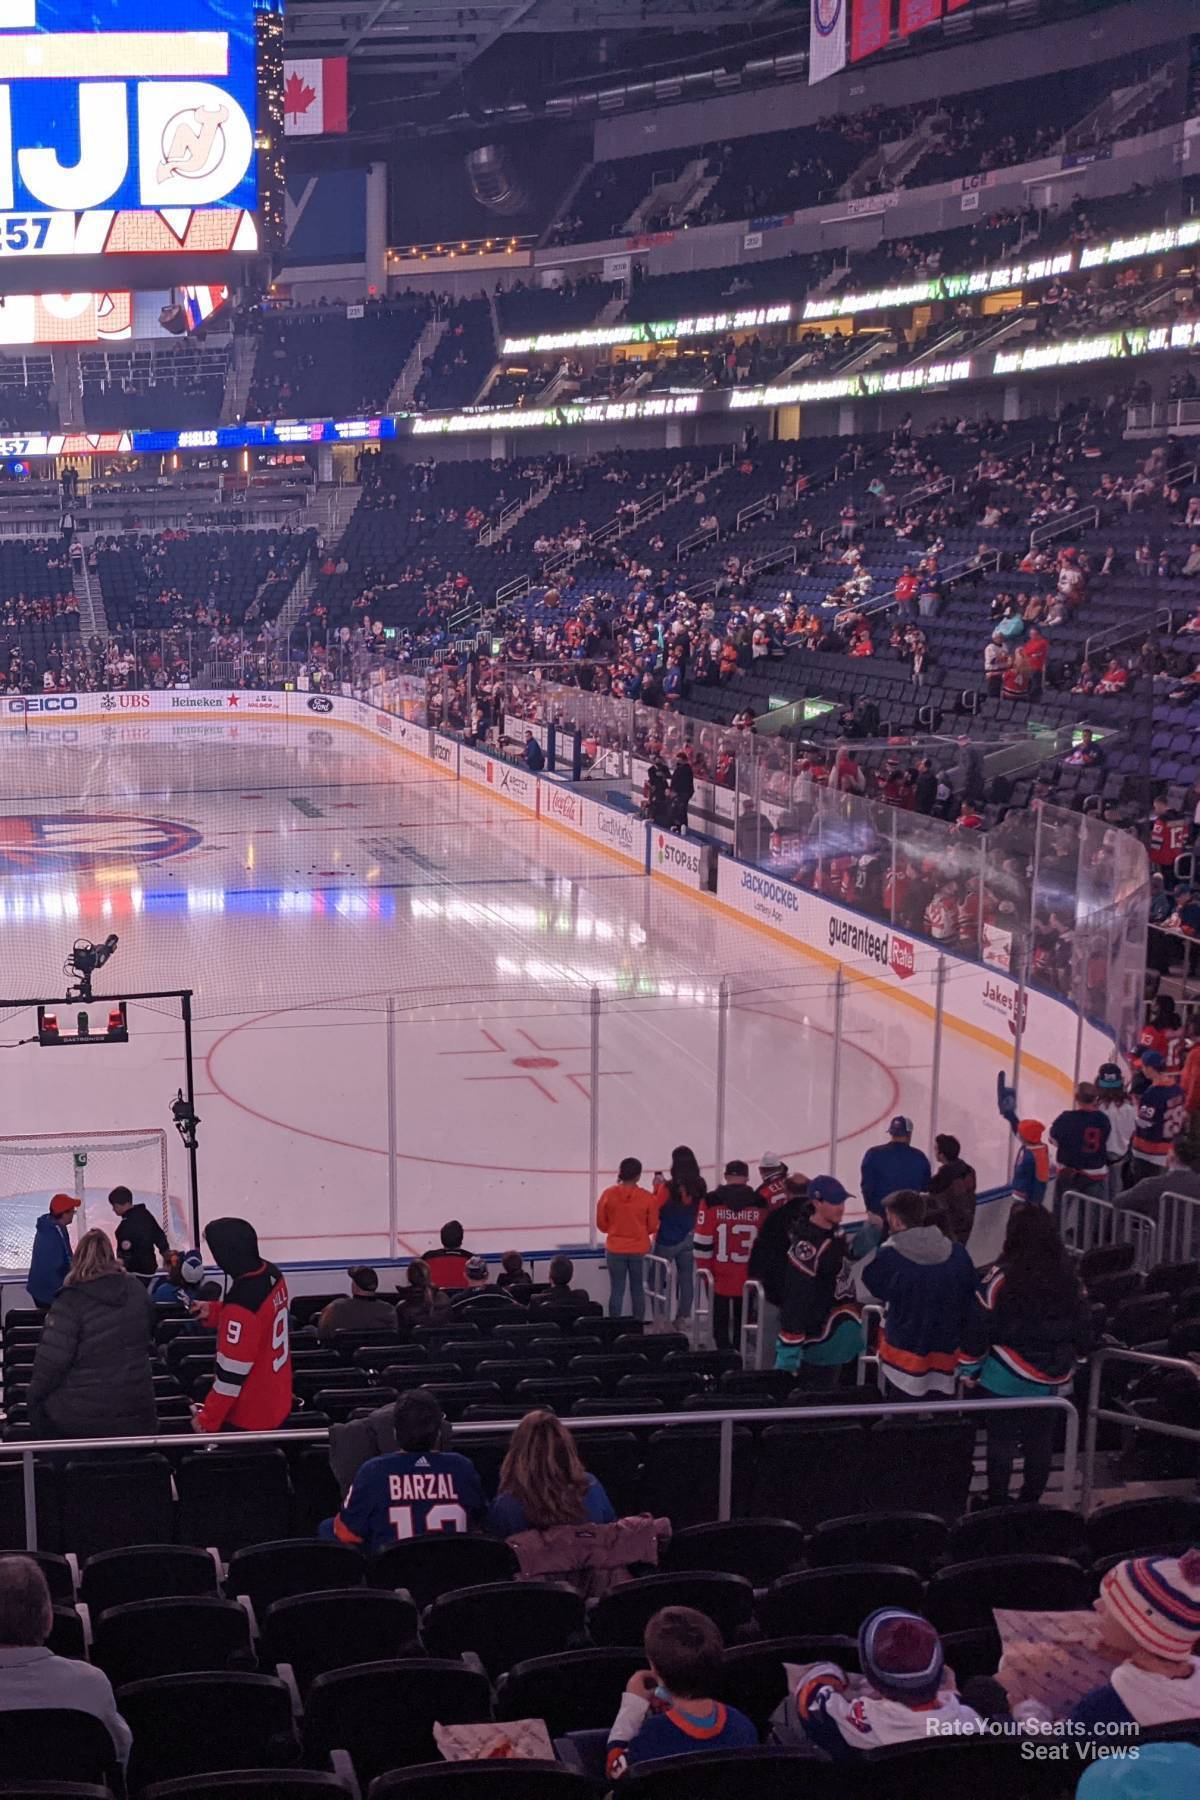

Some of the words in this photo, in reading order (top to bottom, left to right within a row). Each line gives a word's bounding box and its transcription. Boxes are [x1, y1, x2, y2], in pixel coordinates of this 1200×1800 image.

[8, 697, 78, 712] GEICO
[119, 694, 151, 708] UBS
[171, 697, 223, 707] Heineken
[311, 697, 330, 712] Ford
[663, 844, 701, 875] STOP&S
[829, 916, 889, 966] guaranteed
[891, 941, 914, 969] Rate
[982, 980, 1013, 1011] Jakes
[716, 1209, 760, 1221] HISCHIER
[716, 1222, 759, 1263] 13
[226, 1320, 242, 1345] 9
[272, 1307, 289, 1373] 9
[389, 1473, 459, 1500] BARZAL
